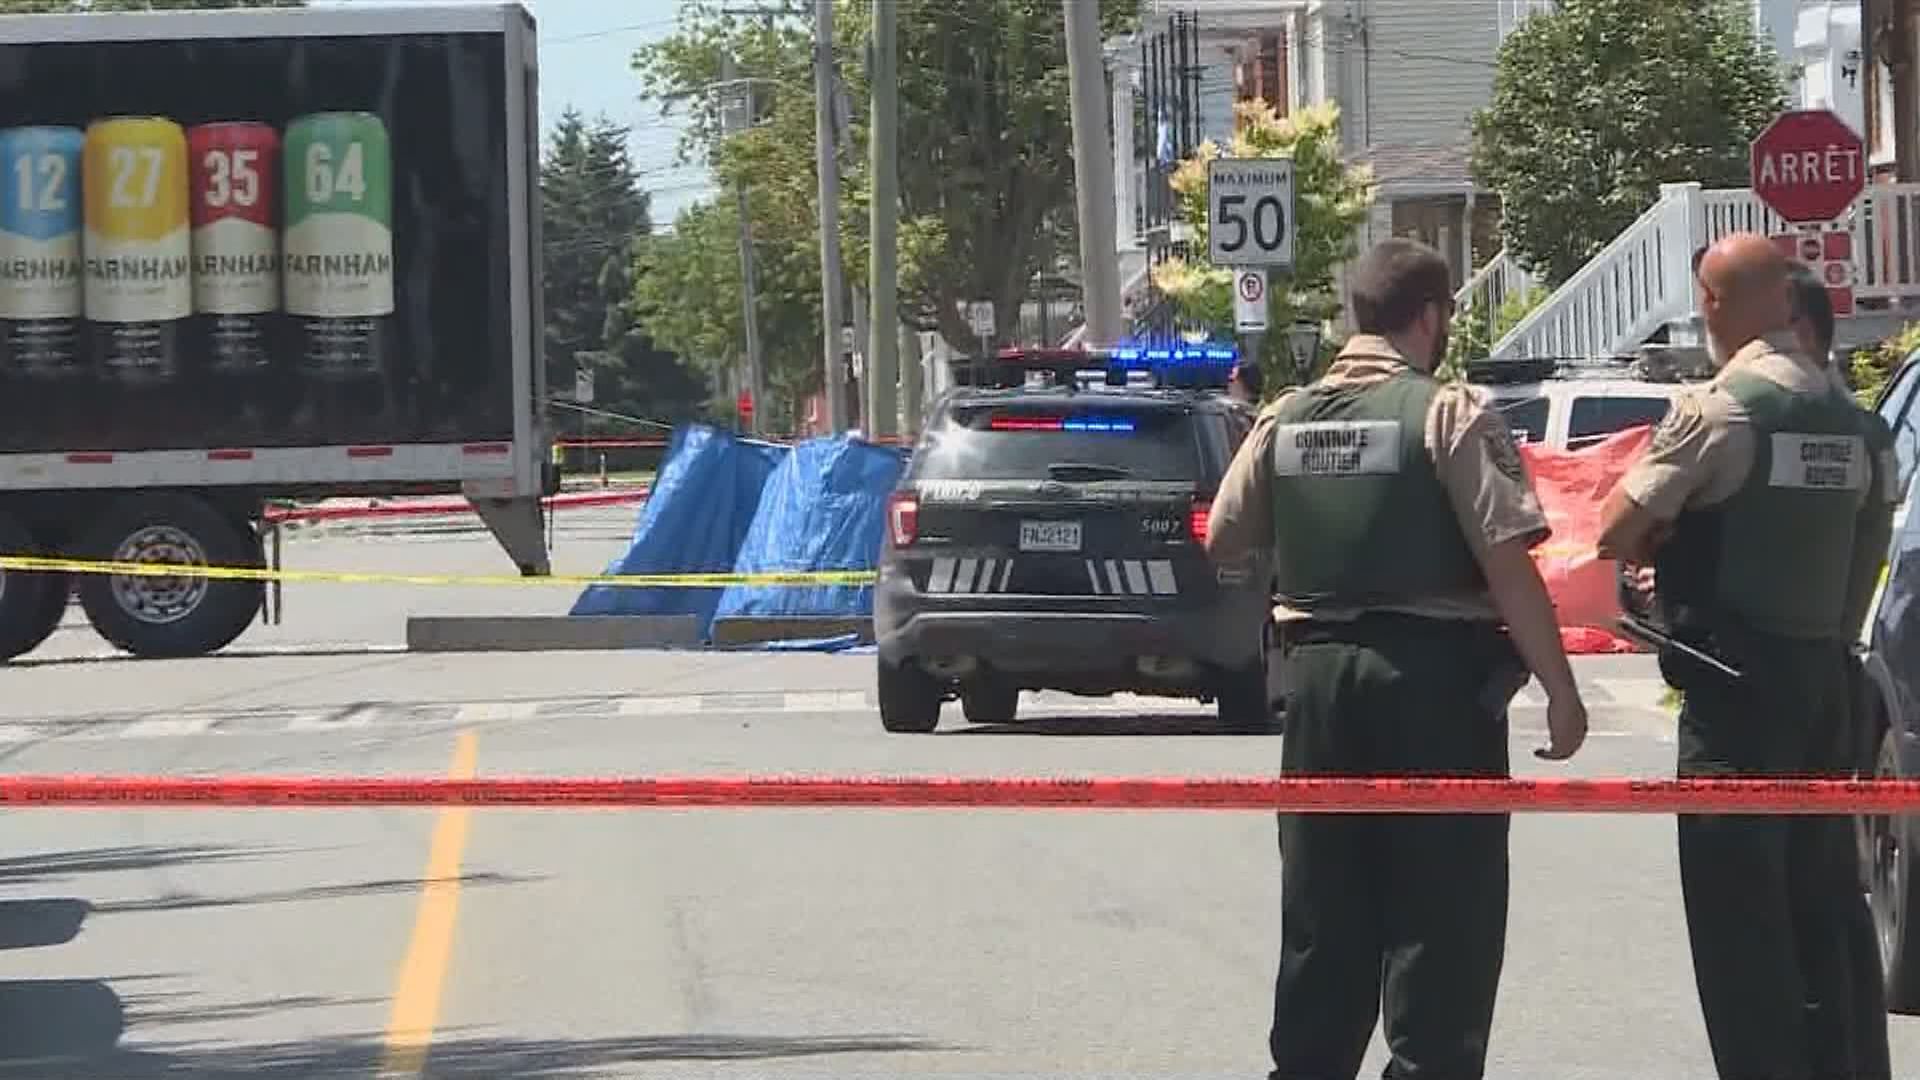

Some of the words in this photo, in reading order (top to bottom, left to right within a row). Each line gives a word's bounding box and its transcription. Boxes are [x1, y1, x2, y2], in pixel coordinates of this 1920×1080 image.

[15, 153, 66, 210] 12
[109, 146, 164, 208] 27
[203, 150, 259, 207] 35
[305, 142, 366, 202] 64
[1214, 171, 1287, 186] MAXIMUM
[1760, 145, 1858, 184] ARRÊT
[1218, 195, 1285, 251] 50
